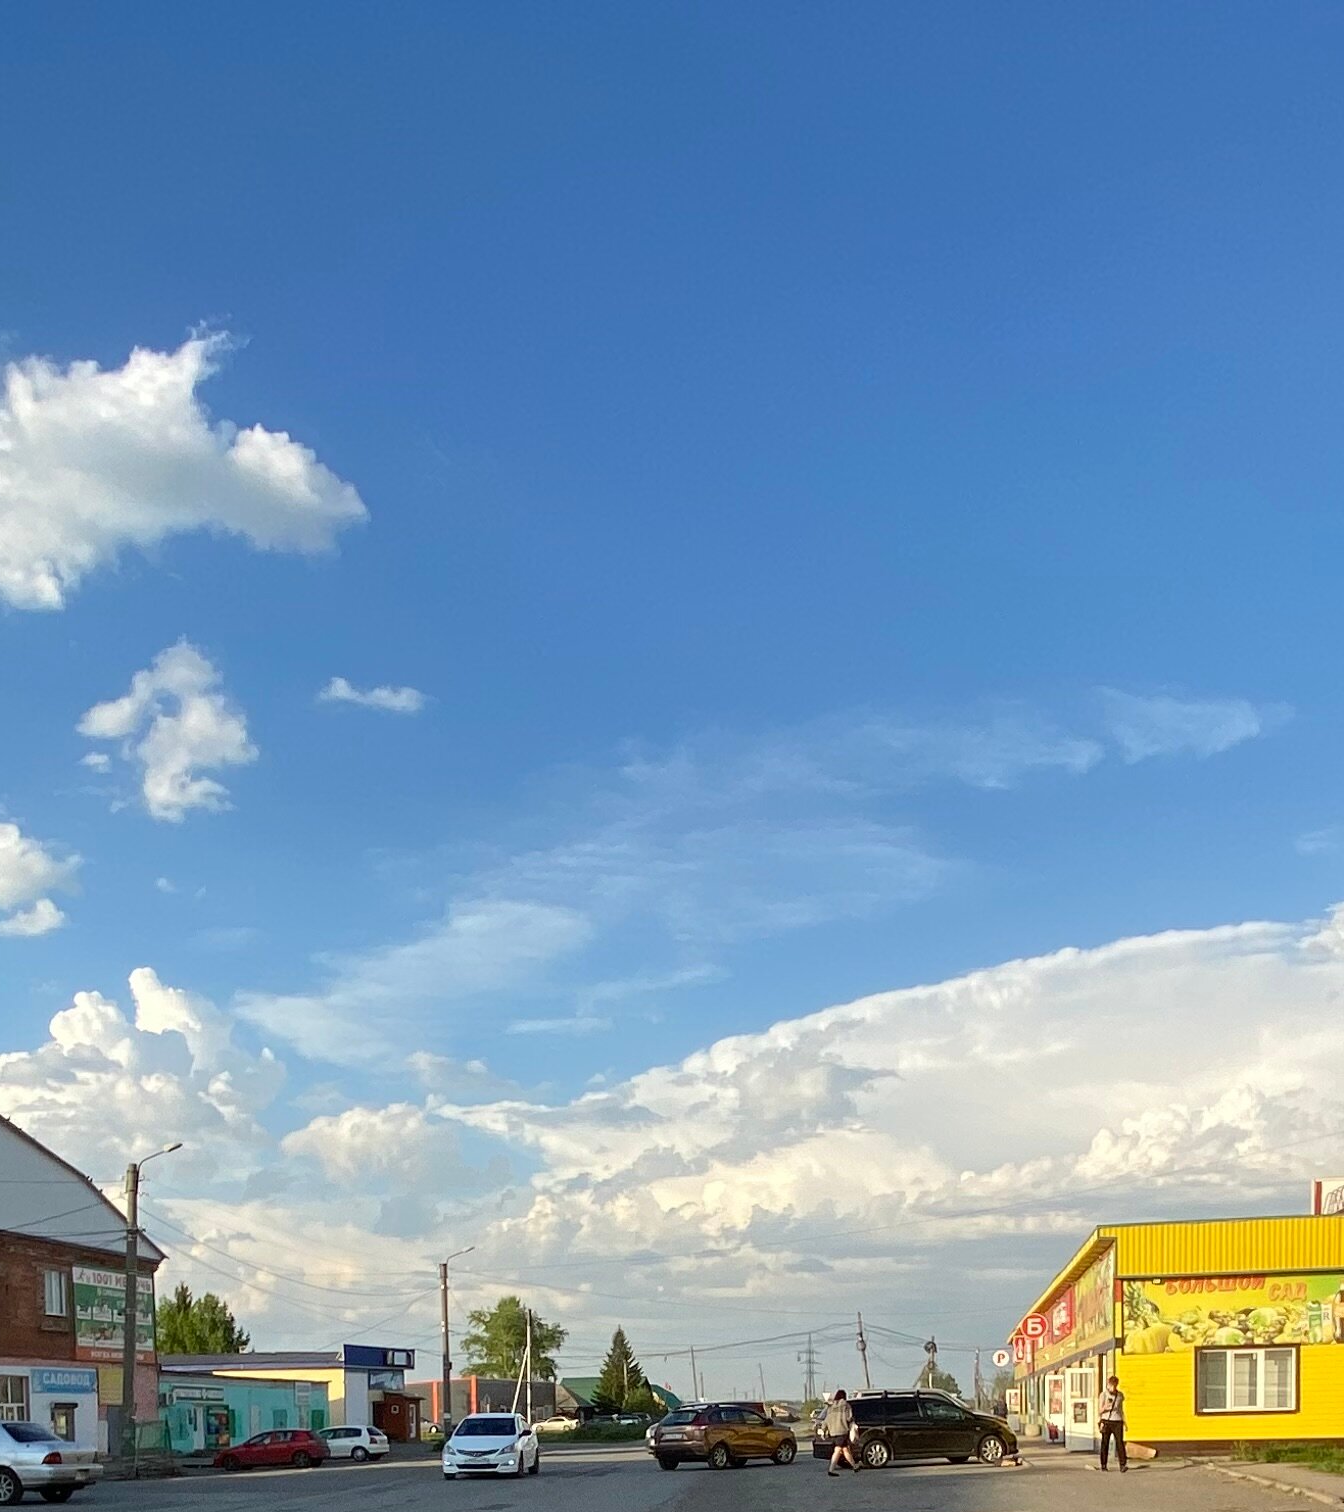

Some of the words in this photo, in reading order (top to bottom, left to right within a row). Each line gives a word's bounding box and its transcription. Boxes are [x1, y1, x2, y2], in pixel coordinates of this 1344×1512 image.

[1268, 1283, 1308, 1301] САД
[1026, 1318, 1043, 1335] Б
[42, 1372, 91, 1387] САДОВОД
